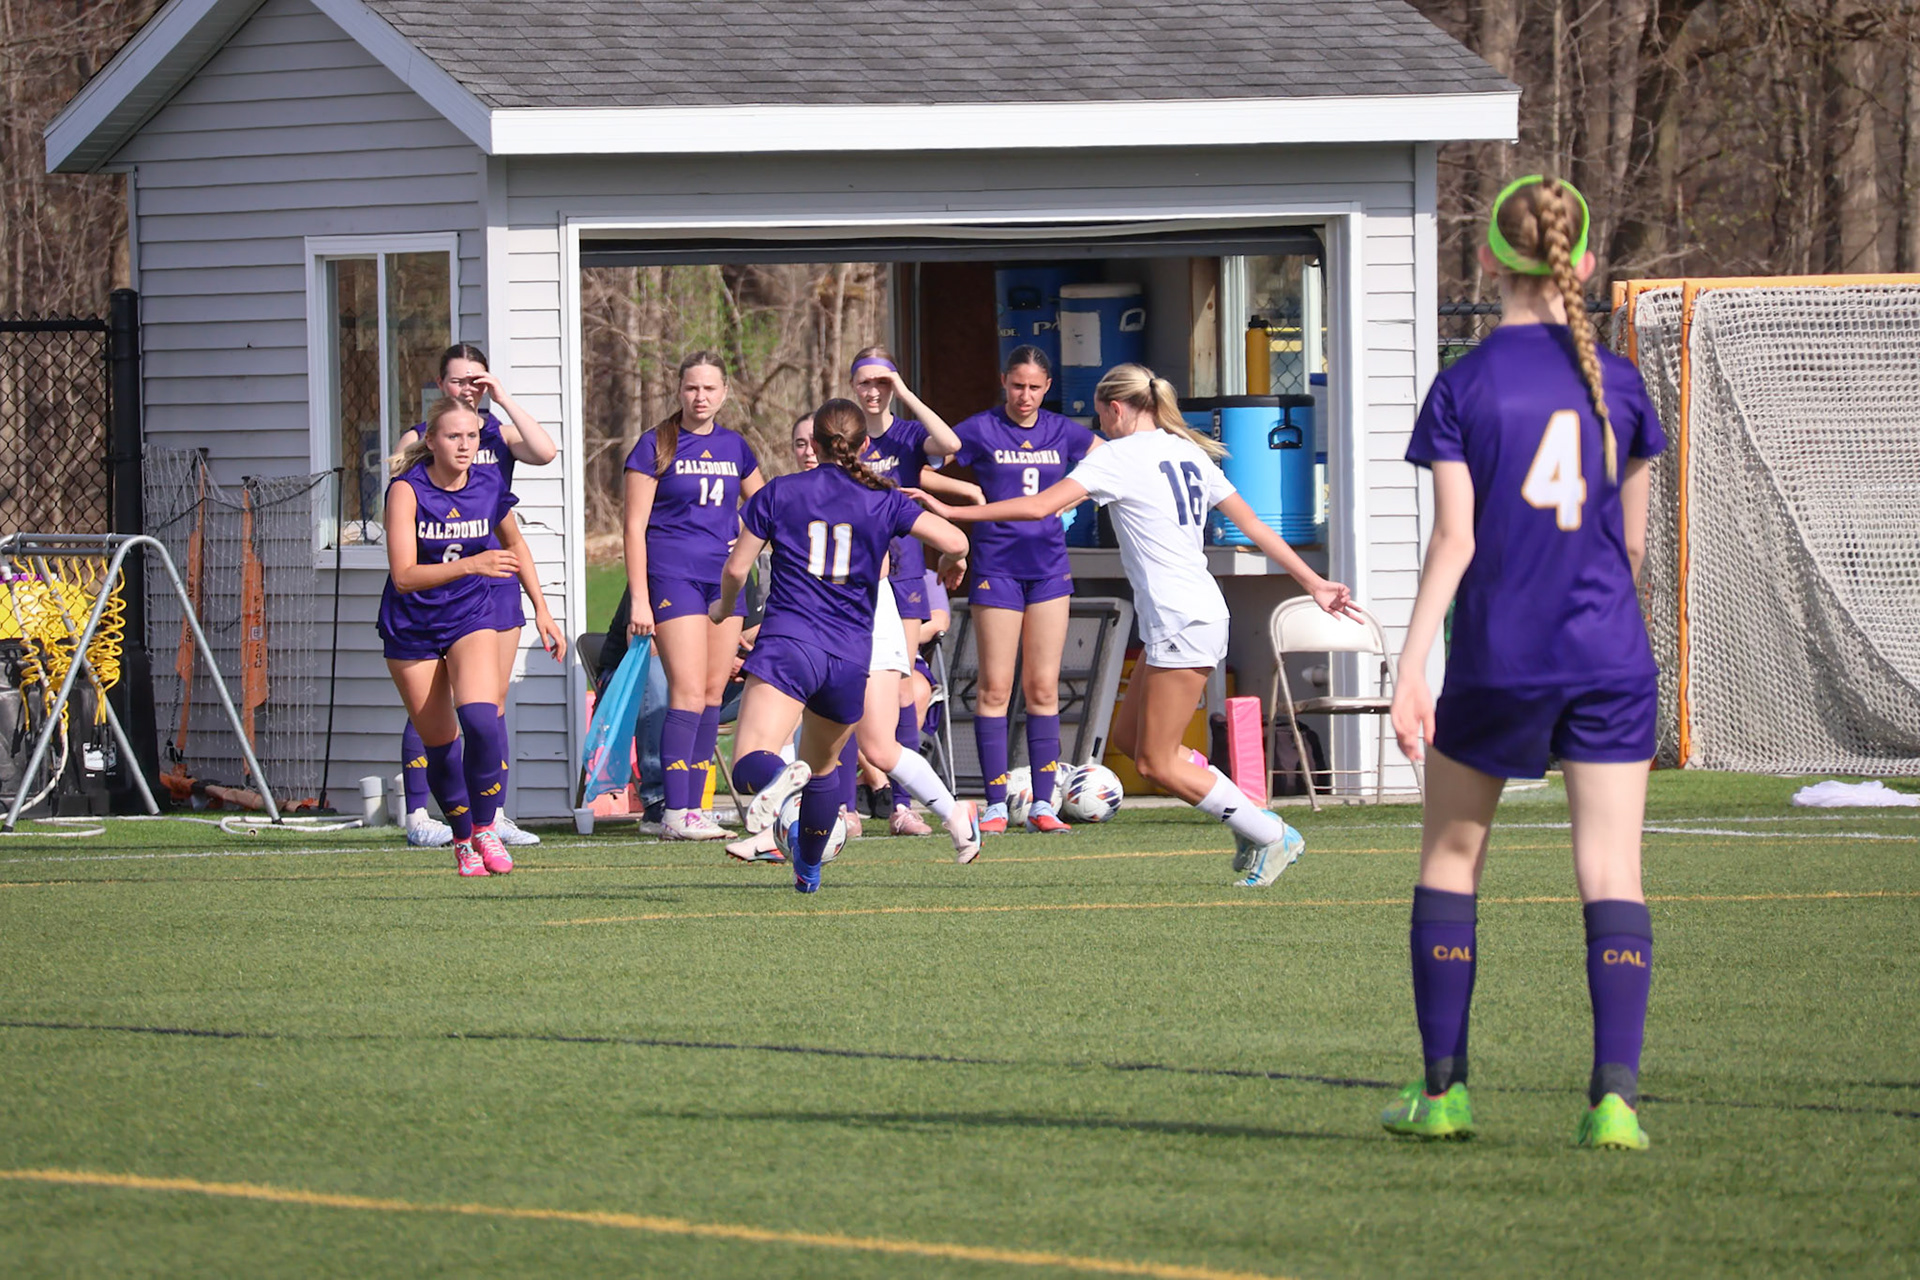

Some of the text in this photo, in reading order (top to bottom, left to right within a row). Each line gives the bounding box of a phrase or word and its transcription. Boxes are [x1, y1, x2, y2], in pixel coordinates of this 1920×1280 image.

[675, 459, 739, 477] CALEDONIA
[994, 449, 1061, 465] CALEDONIA
[1023, 467, 1040, 496] 9
[1521, 409, 1587, 532] 4
[699, 477, 725, 507] 14
[1158, 460, 1204, 526] 16
[418, 518, 489, 540] CALEDONIA
[442, 543, 463, 564] 6
[807, 519, 853, 585] 11
[1432, 944, 1473, 962] CAL
[1602, 949, 1646, 968] CAL
